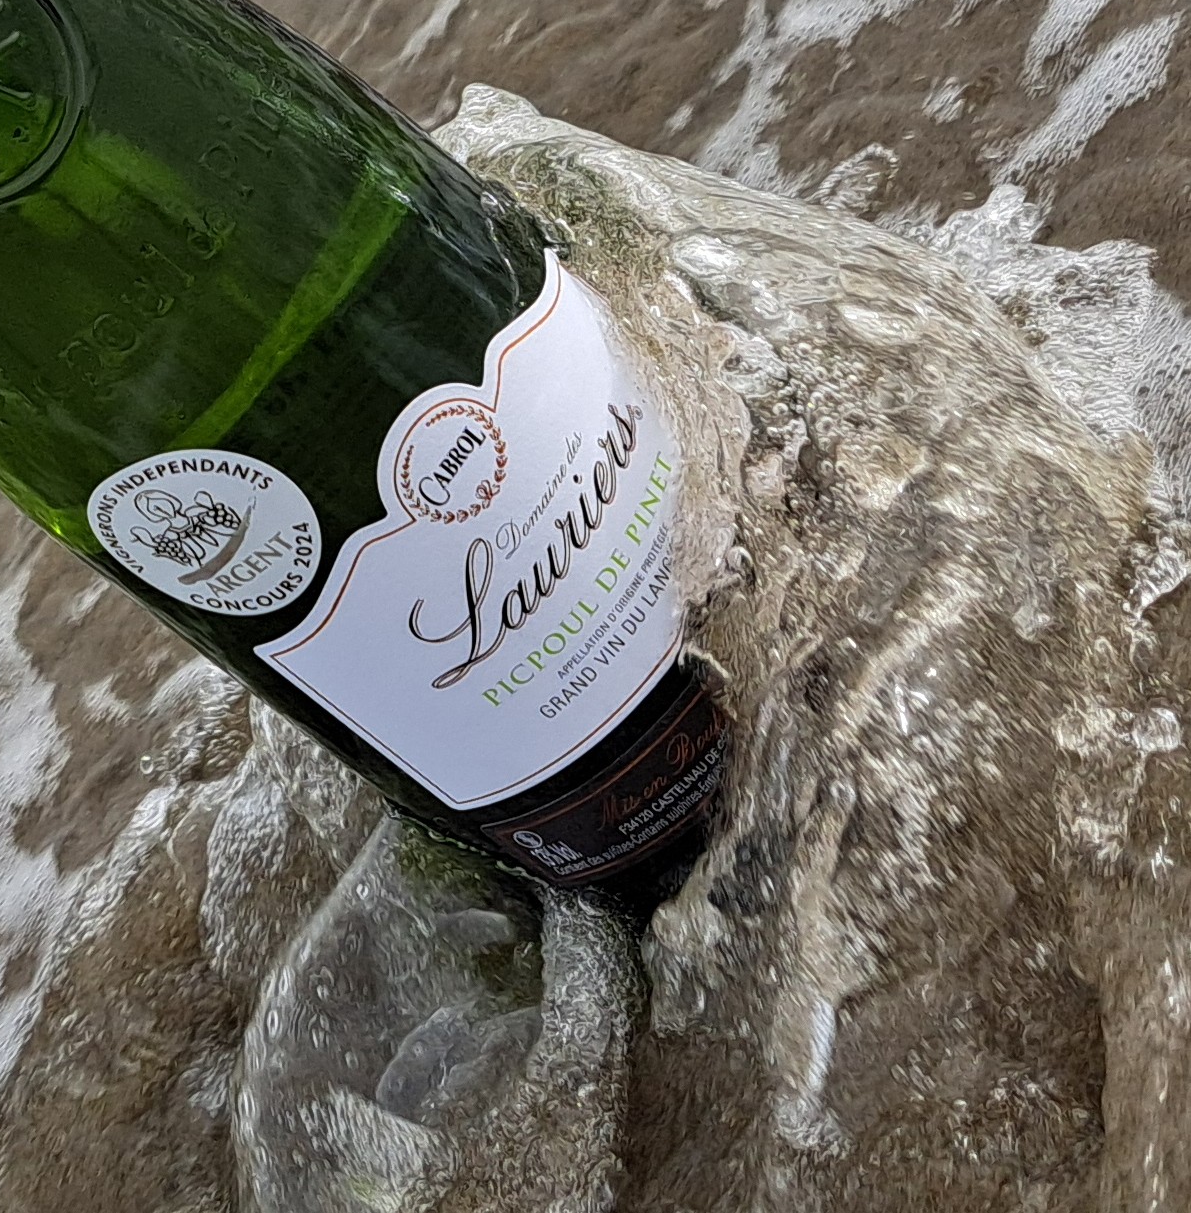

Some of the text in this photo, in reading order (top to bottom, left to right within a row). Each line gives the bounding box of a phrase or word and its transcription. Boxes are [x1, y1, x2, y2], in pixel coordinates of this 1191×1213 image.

[97, 458, 274, 574] VIGNERONS INDEPENDANTS
[418, 426, 487, 506] CABROL
[495, 432, 582, 559] Domaine des
[190, 522, 310, 611] CONCOURS 2024
[206, 531, 294, 598] ARGENT
[409, 402, 637, 688] Lauriers
[482, 451, 673, 707] PICPOUL DE PINET
[540, 666, 598, 719] GRAND
[594, 634, 625, 666] VIN
[621, 606, 646, 636] DU
[558, 620, 610, 679] APPELLATION
[608, 572, 646, 622] D'ORIGINE
[618, 748, 720, 836] F34120 CASTELNAU DE
